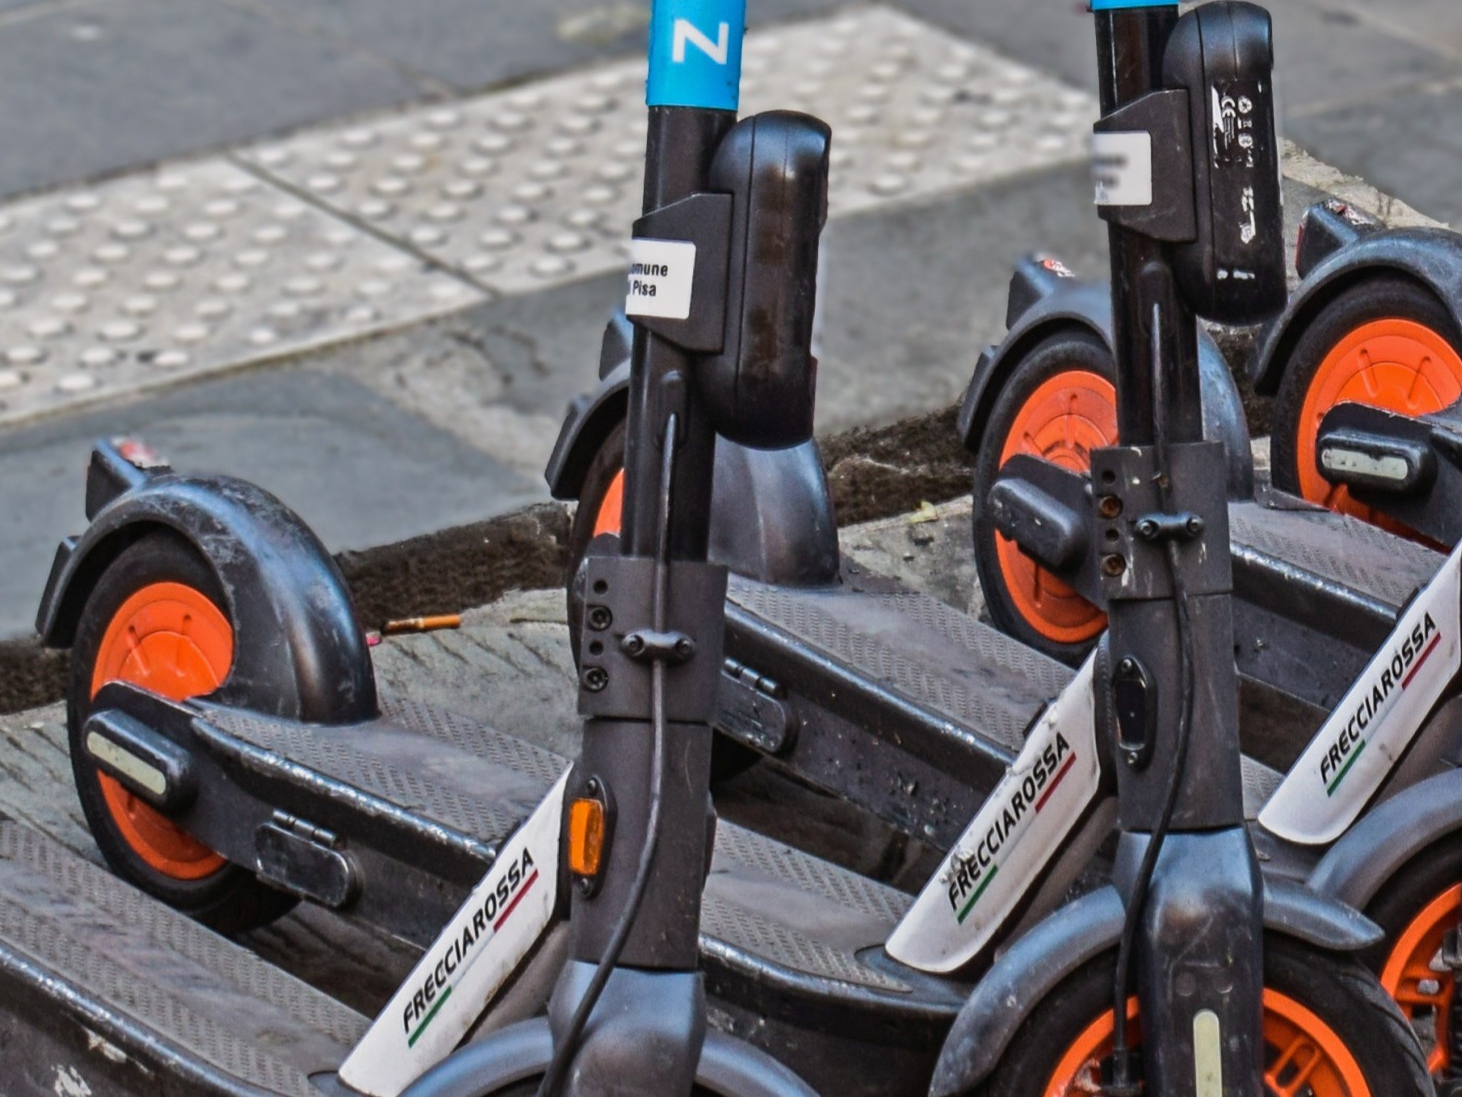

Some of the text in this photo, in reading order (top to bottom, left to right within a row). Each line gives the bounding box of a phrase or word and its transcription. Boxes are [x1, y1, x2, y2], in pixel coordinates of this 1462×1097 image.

[633, 279, 657, 297] Pisa
[1320, 612, 1437, 785] FRECCIAROSSA
[947, 732, 1071, 912] FRECCIAROSSA
[402, 846, 535, 1034] FRECCIAROSSA
